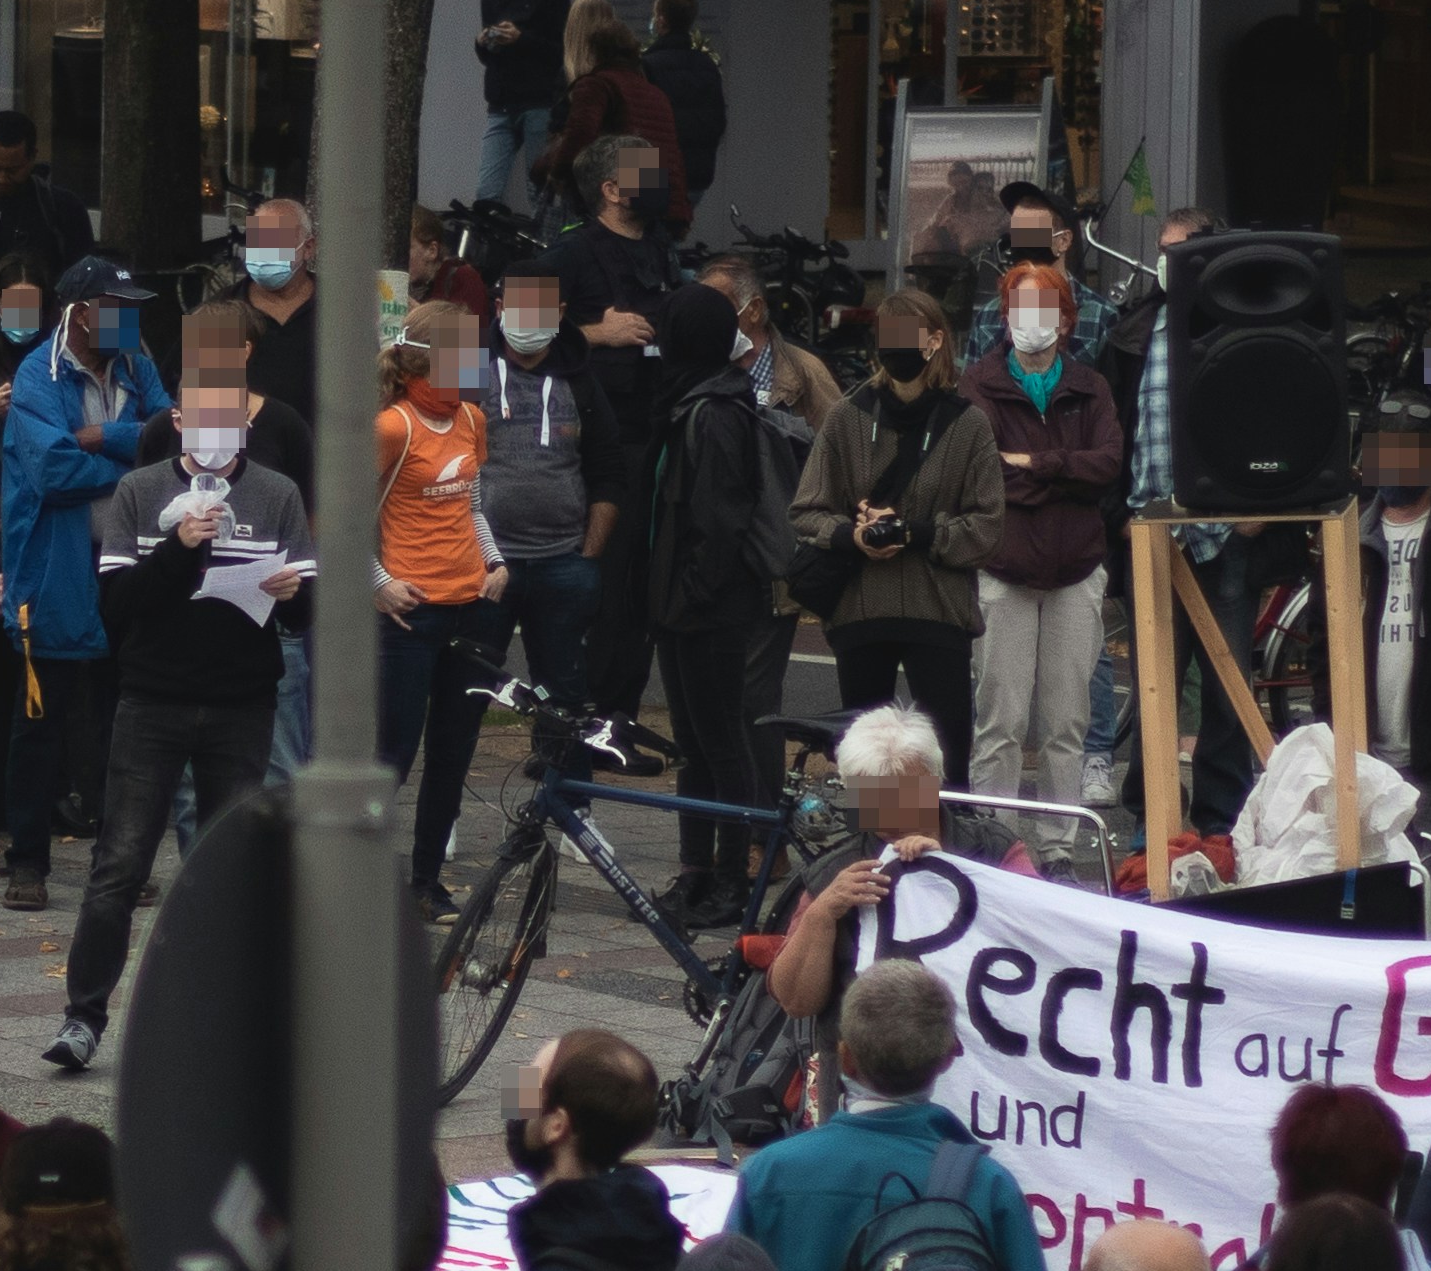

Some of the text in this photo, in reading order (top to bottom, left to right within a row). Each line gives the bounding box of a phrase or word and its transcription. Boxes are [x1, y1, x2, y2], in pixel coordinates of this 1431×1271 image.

[871, 852, 1226, 1089] Recht
[1235, 1003, 1353, 1088] auf
[971, 1090, 1086, 1150] und
